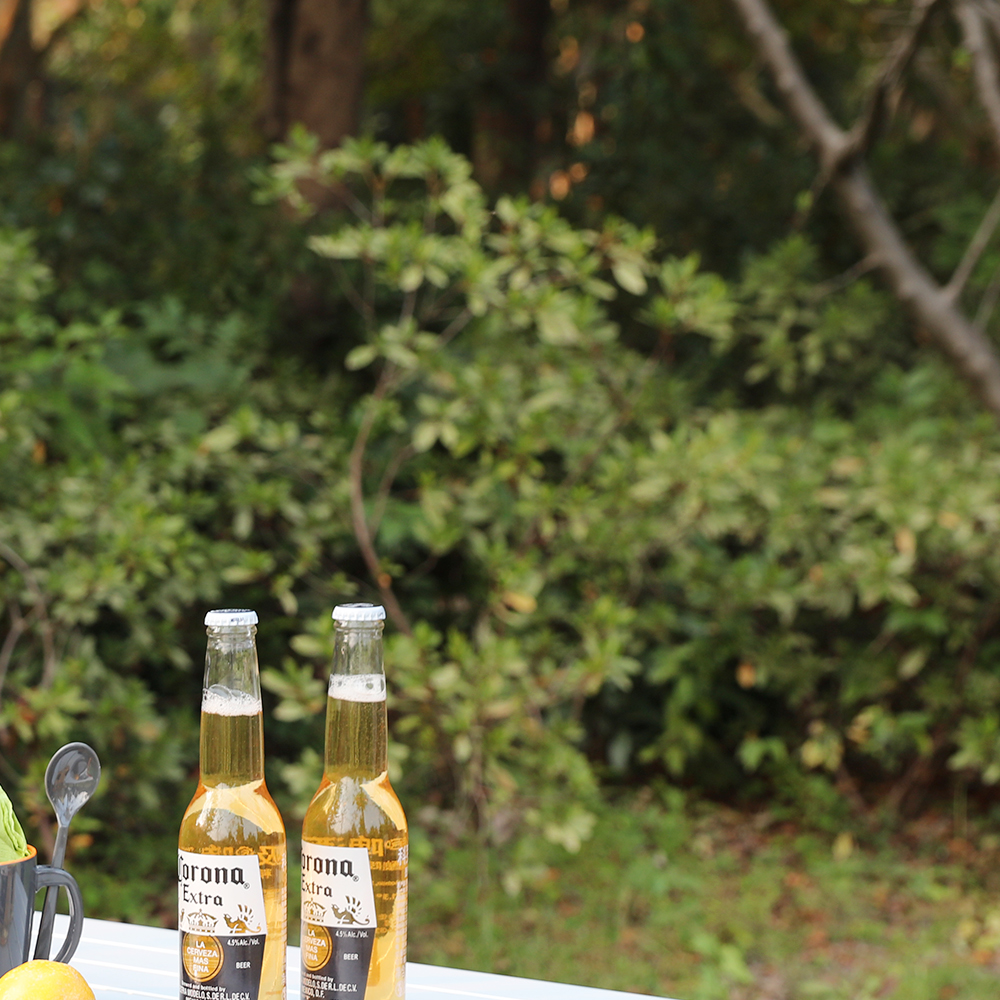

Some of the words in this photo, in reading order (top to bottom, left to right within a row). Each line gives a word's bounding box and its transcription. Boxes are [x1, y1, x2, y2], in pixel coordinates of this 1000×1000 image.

[302, 853, 354, 878] orona
[183, 883, 223, 907] Extra
[195, 940, 206, 949] LA
[186, 947, 219, 958] CERVEZA
[343, 953, 359, 961] BEER
[192, 956, 210, 965] MAS
[235, 961, 251, 969] BEER
